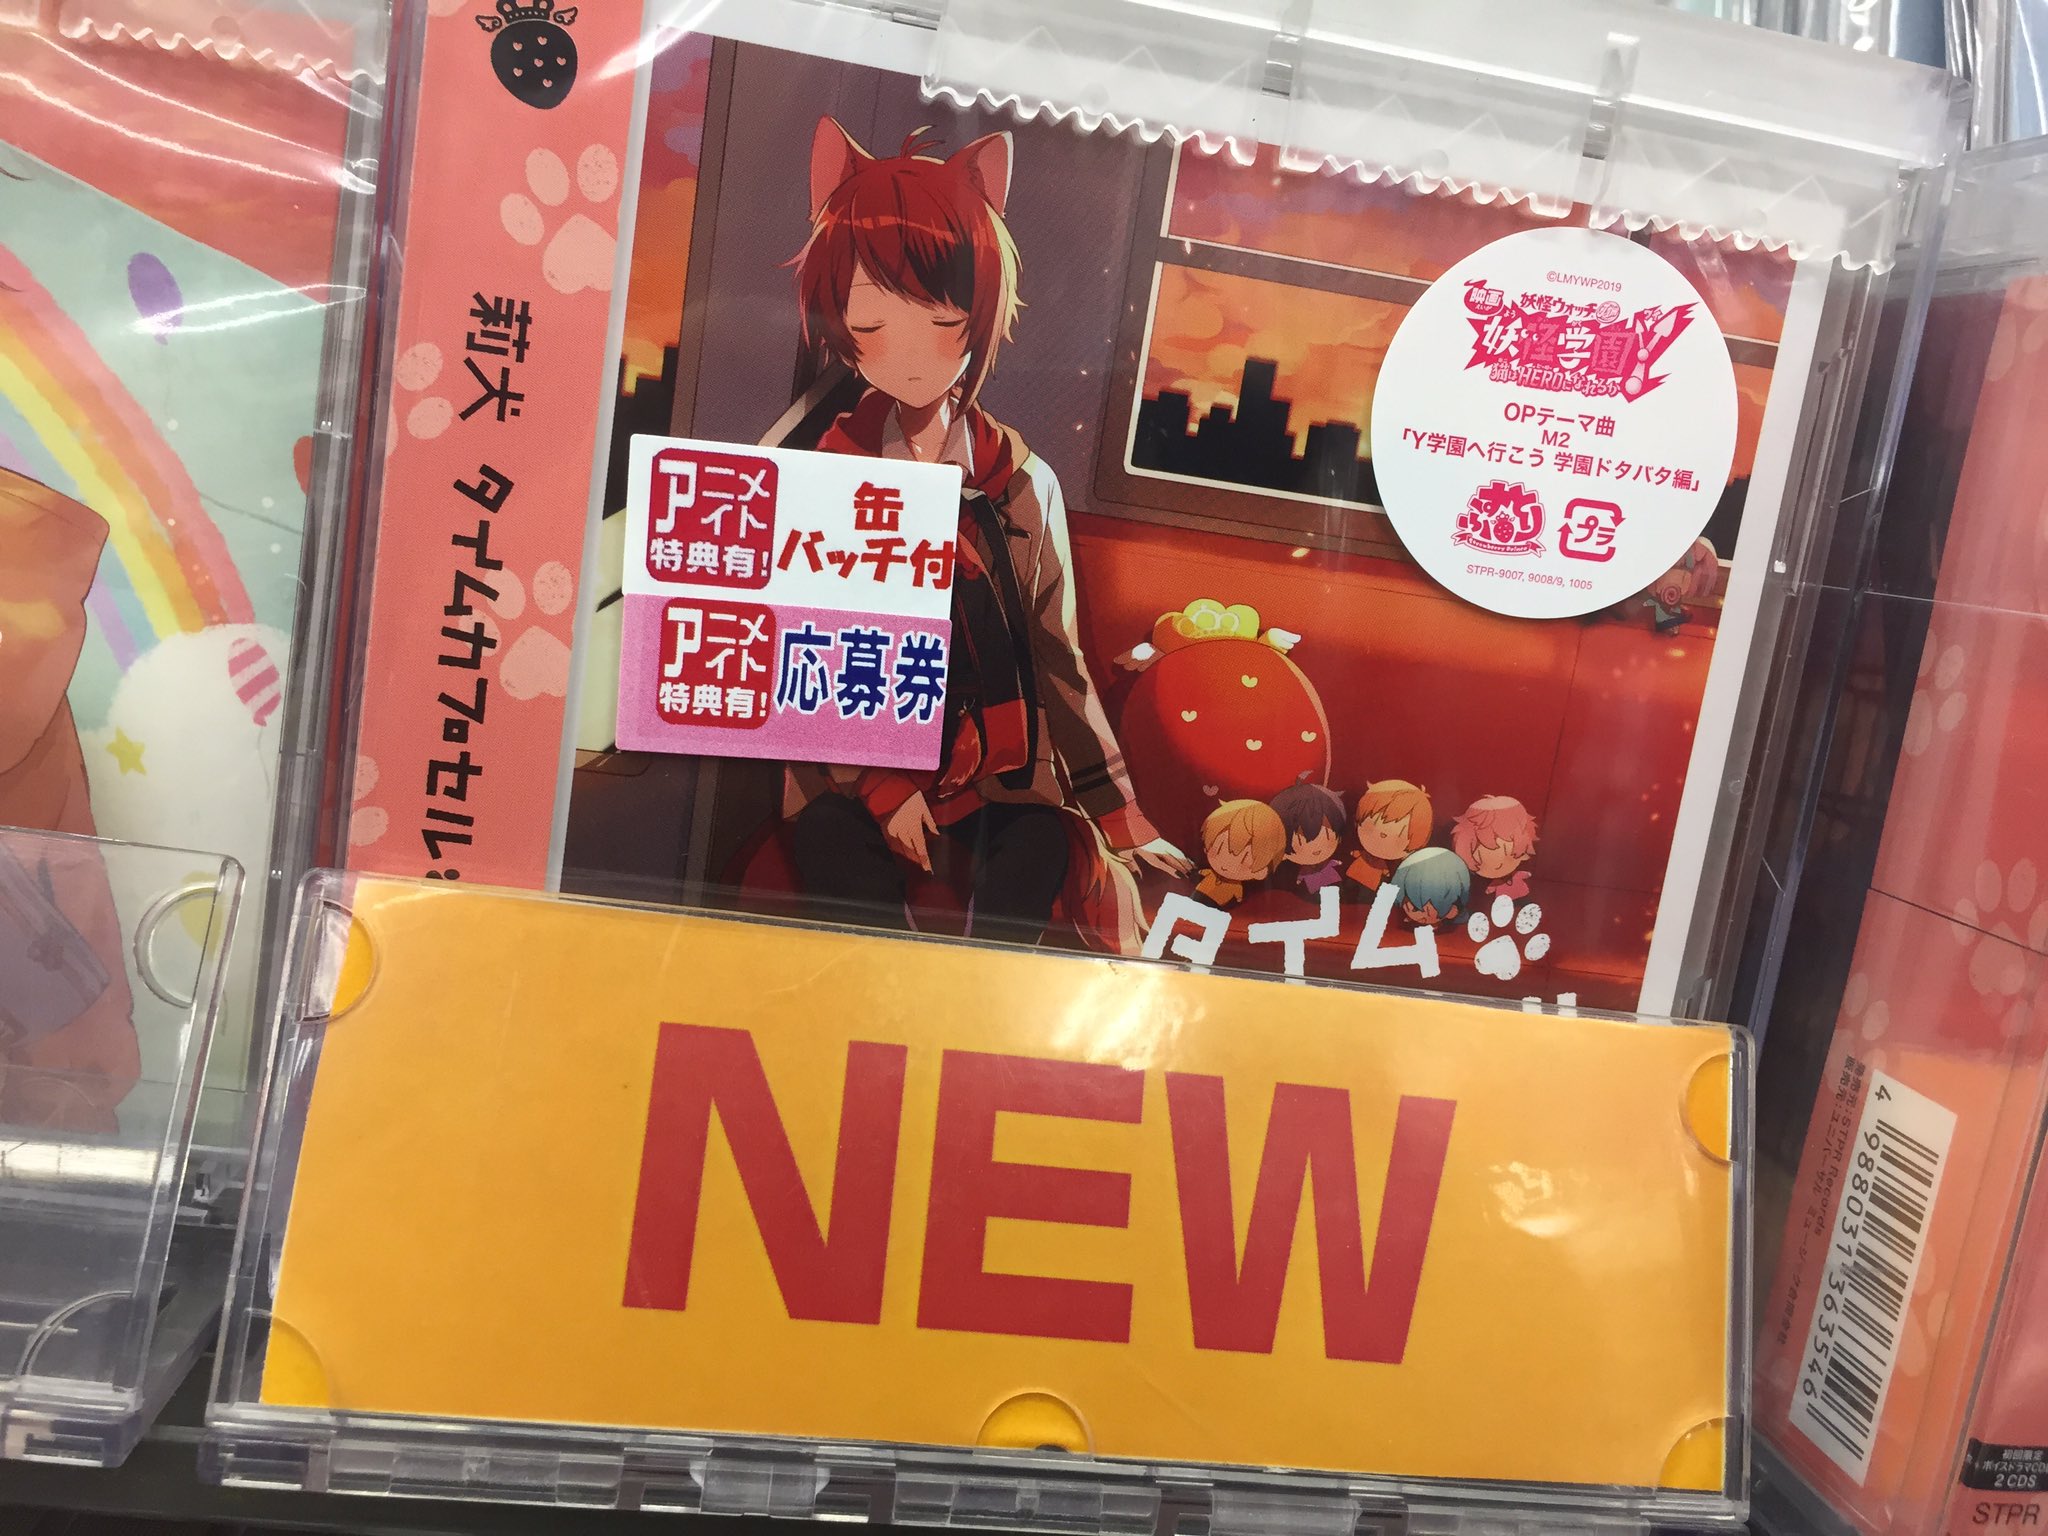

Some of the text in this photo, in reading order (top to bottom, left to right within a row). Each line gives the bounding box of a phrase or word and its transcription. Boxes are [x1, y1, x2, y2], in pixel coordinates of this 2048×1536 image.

[1546, 270, 1622, 292] ©LMYWP2019
[1470, 288, 1503, 306] 映画
[1504, 402, 1616, 437] OPテーマ曲
[1541, 429, 1571, 448] M2
[1402, 428, 1700, 492] 「Y学園へ行こう 学園ドタバタ編」
[854, 481, 904, 531] 缶
[1574, 515, 1616, 546] プラ
[777, 529, 956, 590] バッチ付
[421, 291, 531, 860] 莉犬 タイムカプセル
[1466, 564, 1593, 591] STPR-9007, 9008/9, 1005
[776, 622, 949, 723] 応募券
[1875, 1084, 1892, 1102] 4
[621, 1021, 1457, 1365] NEW
[1836, 1130, 1881, 1258] 988031
[1982, 1460, 2048, 1473] ボイスドラマCD
[1994, 1473, 2038, 1489] 2 CDS
[1972, 1502, 2041, 1525] STPR
